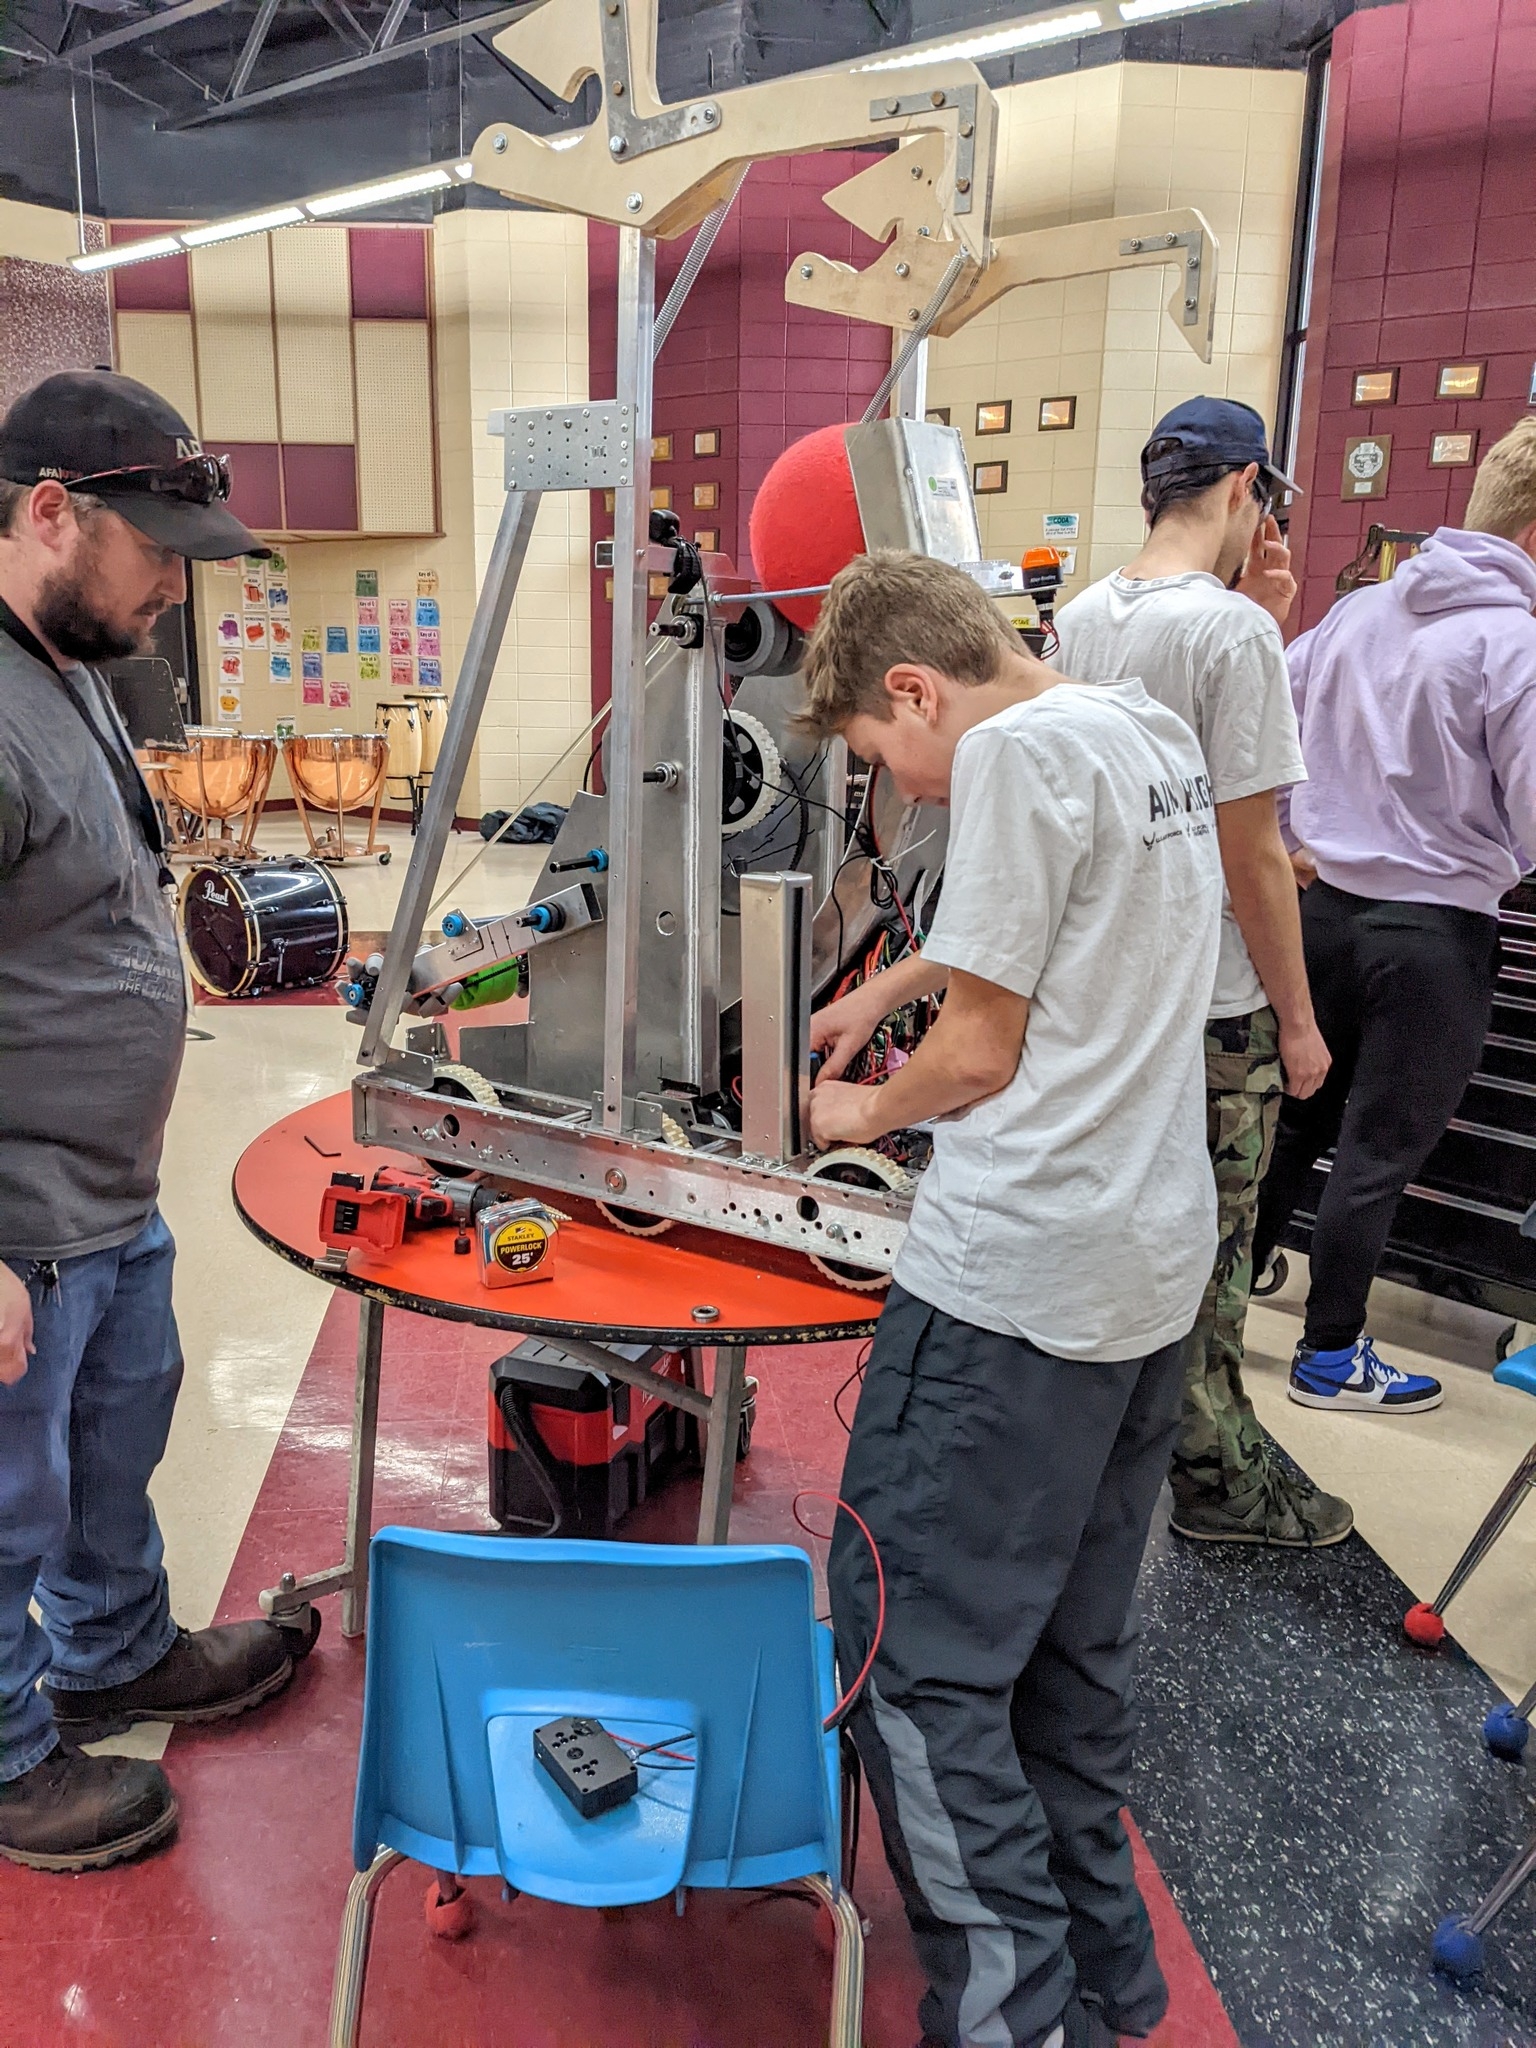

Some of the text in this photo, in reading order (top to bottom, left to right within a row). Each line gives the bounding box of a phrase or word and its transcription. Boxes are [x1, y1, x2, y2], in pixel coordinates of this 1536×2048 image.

[202, 880, 229, 903] Pearl
[507, 1233, 535, 1241] STANLEY
[500, 1242, 542, 1254] POWERLOCK
[512, 1252, 533, 1266] 25'
